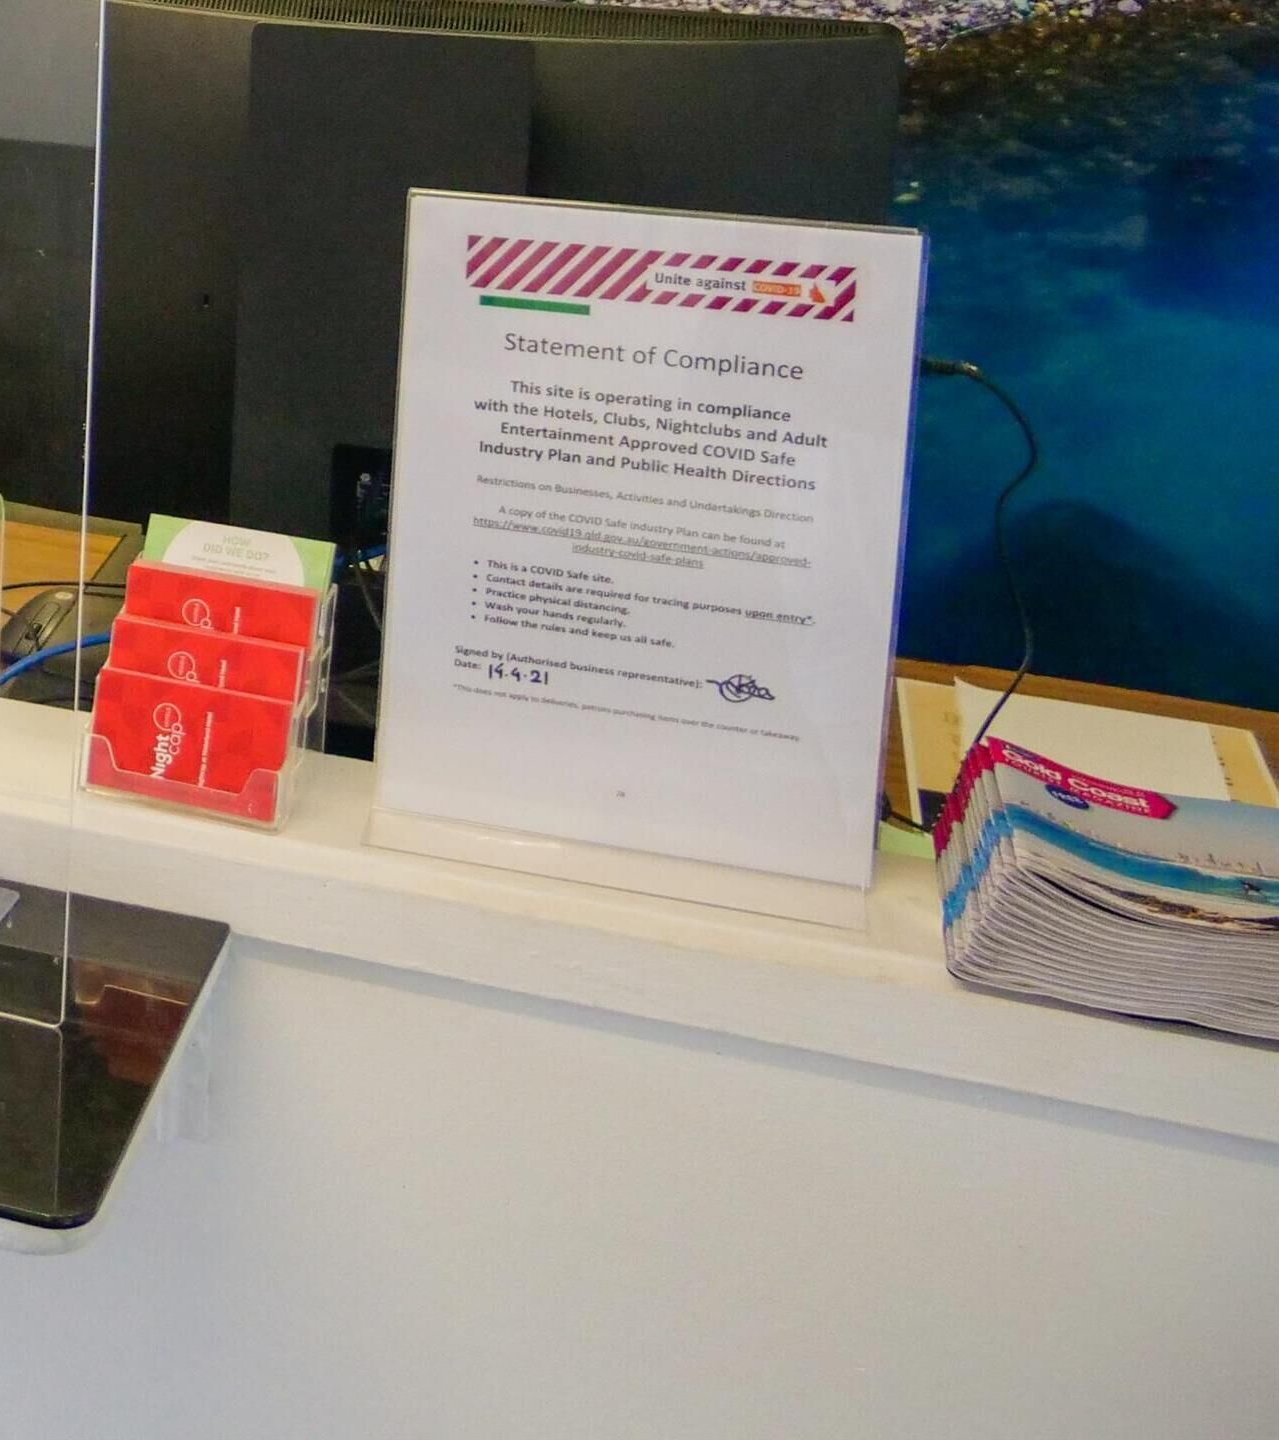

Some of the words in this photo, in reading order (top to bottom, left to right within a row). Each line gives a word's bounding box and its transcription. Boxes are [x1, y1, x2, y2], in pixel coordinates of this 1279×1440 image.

[655, 272, 691, 286] Unite
[696, 278, 746, 291] against
[504, 332, 625, 362] Statement
[633, 346, 658, 365] of
[664, 348, 804, 380] Compliance
[511, 381, 542, 395] This
[546, 385, 574, 399] site
[579, 388, 590, 400] is
[595, 391, 673, 412] operating
[677, 398, 692, 411] in
[697, 401, 791, 422] compliance
[474, 399, 508, 413] with
[514, 402, 539, 416] the
[543, 406, 598, 425] Hotels,
[603, 412, 651, 430] Clubs,
[656, 418, 741, 438] Nightclubs
[746, 429, 777, 442] and
[782, 431, 828, 448] Adult
[501, 422, 614, 446] Entertainment
[618, 435, 698, 456] Approved
[703, 444, 755, 461] COVID
[761, 450, 795, 467] Safe
[479, 441, 543, 461] Industry
[548, 449, 581, 463] Plan
[586, 454, 616, 467] and
[621, 456, 670, 474] Public
[673, 463, 727, 480] Health
[732, 469, 816, 490] Directions
[485, 588, 527, 600] Practice
[529, 594, 571, 607] physical
[574, 601, 630, 616] distancing.
[485, 602, 514, 612] Wash
[516, 607, 540, 615] your
[542, 610, 574, 621] hands
[577, 615, 627, 628] regularly.
[454, 659, 481, 670] Date:
[1067, 773, 1150, 810] Coast
